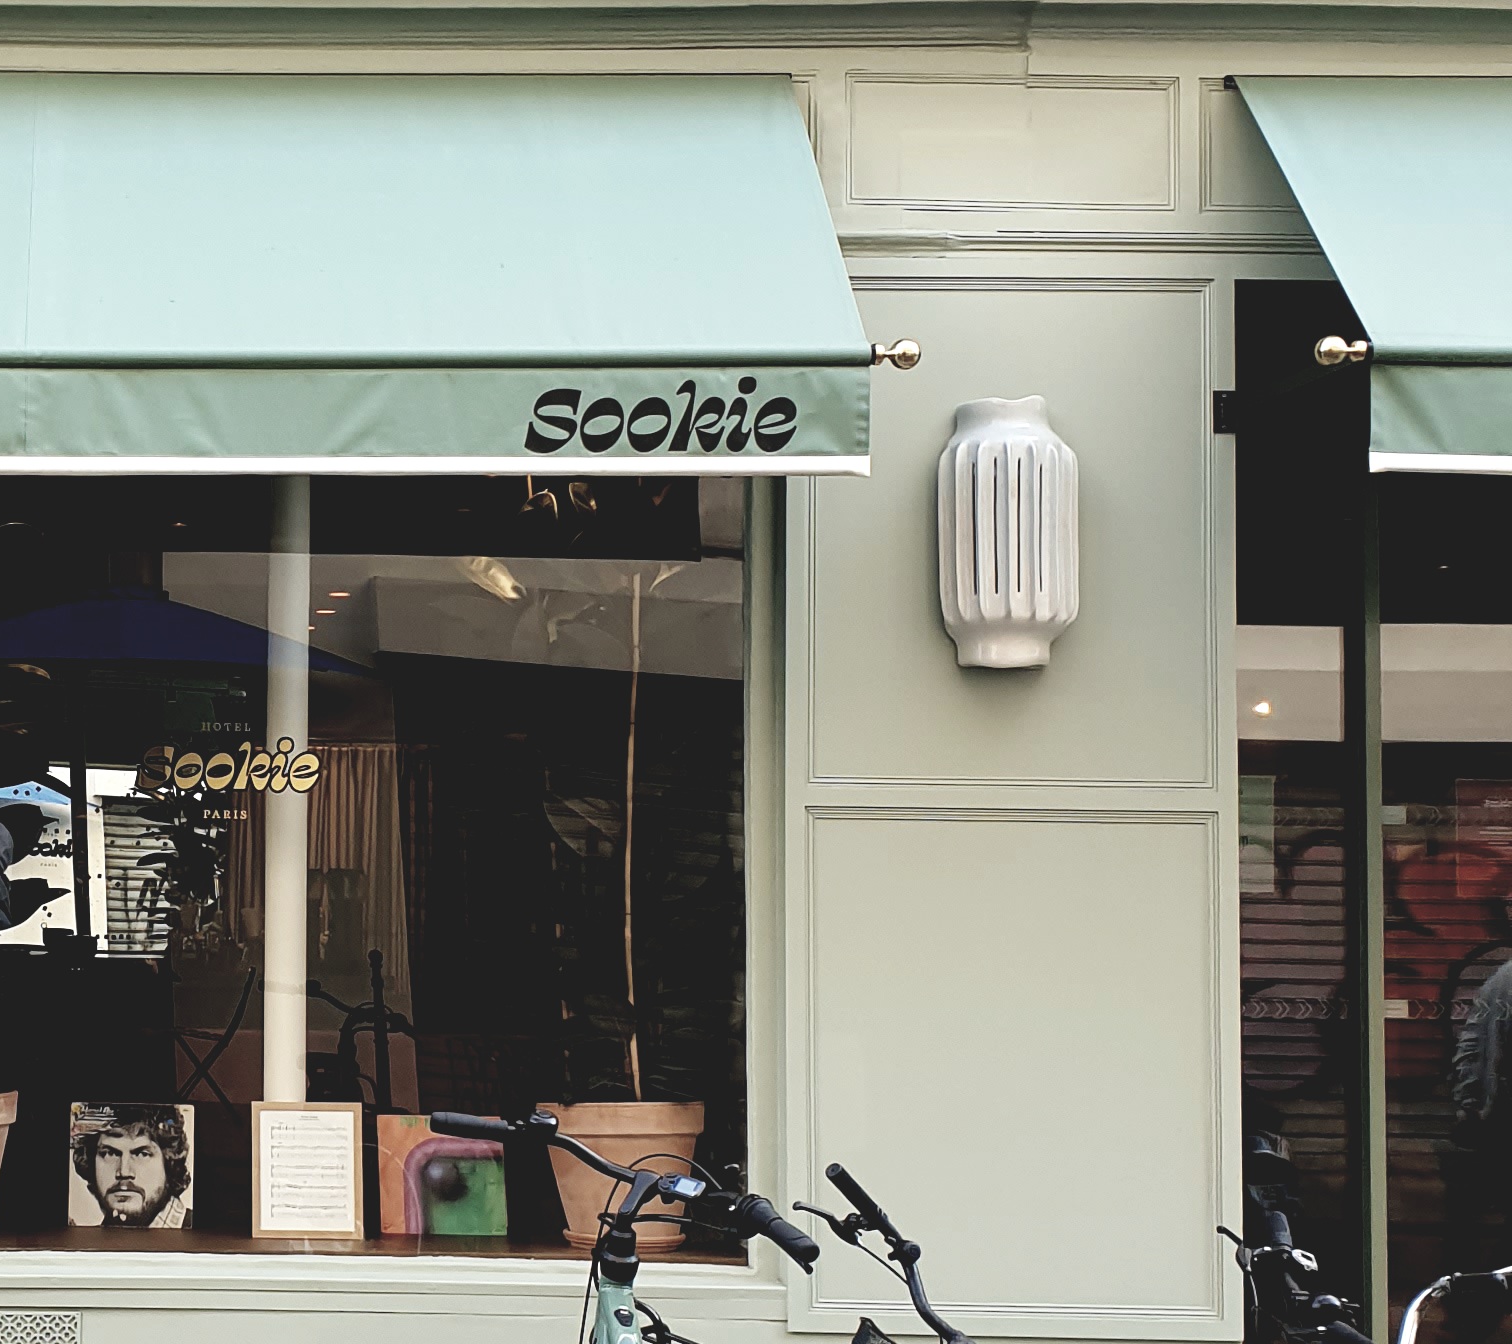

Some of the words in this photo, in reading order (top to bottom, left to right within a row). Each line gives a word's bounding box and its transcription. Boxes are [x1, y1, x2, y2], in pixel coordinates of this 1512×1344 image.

[524, 376, 797, 454] Sookie
[201, 722, 251, 732] HOTEL
[138, 738, 320, 792] Sookie
[203, 810, 248, 820] PARIS
